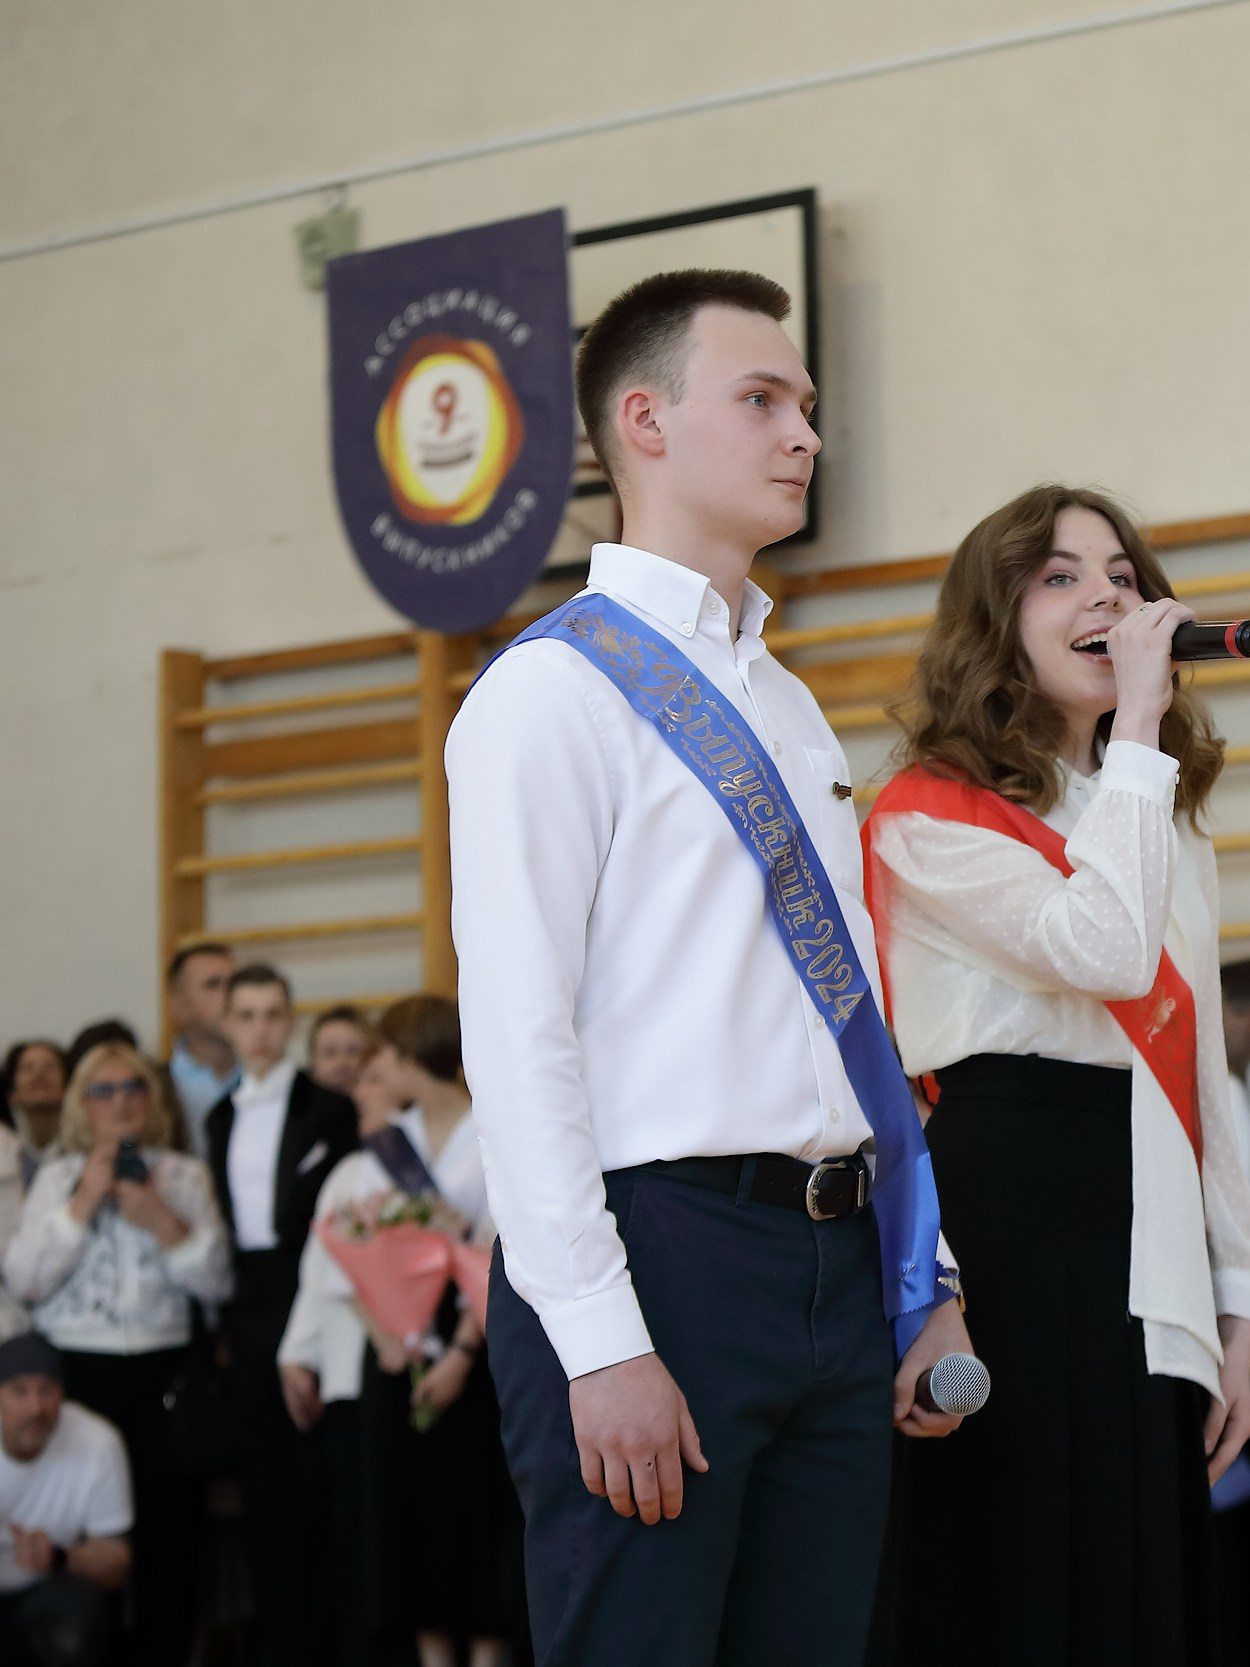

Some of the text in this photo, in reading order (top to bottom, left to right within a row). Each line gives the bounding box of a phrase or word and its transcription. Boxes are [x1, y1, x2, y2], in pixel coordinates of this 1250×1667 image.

[363, 287, 532, 379] АССОЦИАЦИЯ
[432, 382, 457, 435] 9
[370, 488, 538, 574] ВЫПУСКНИКОВ
[628, 663, 865, 1025] Выпускник 2024
